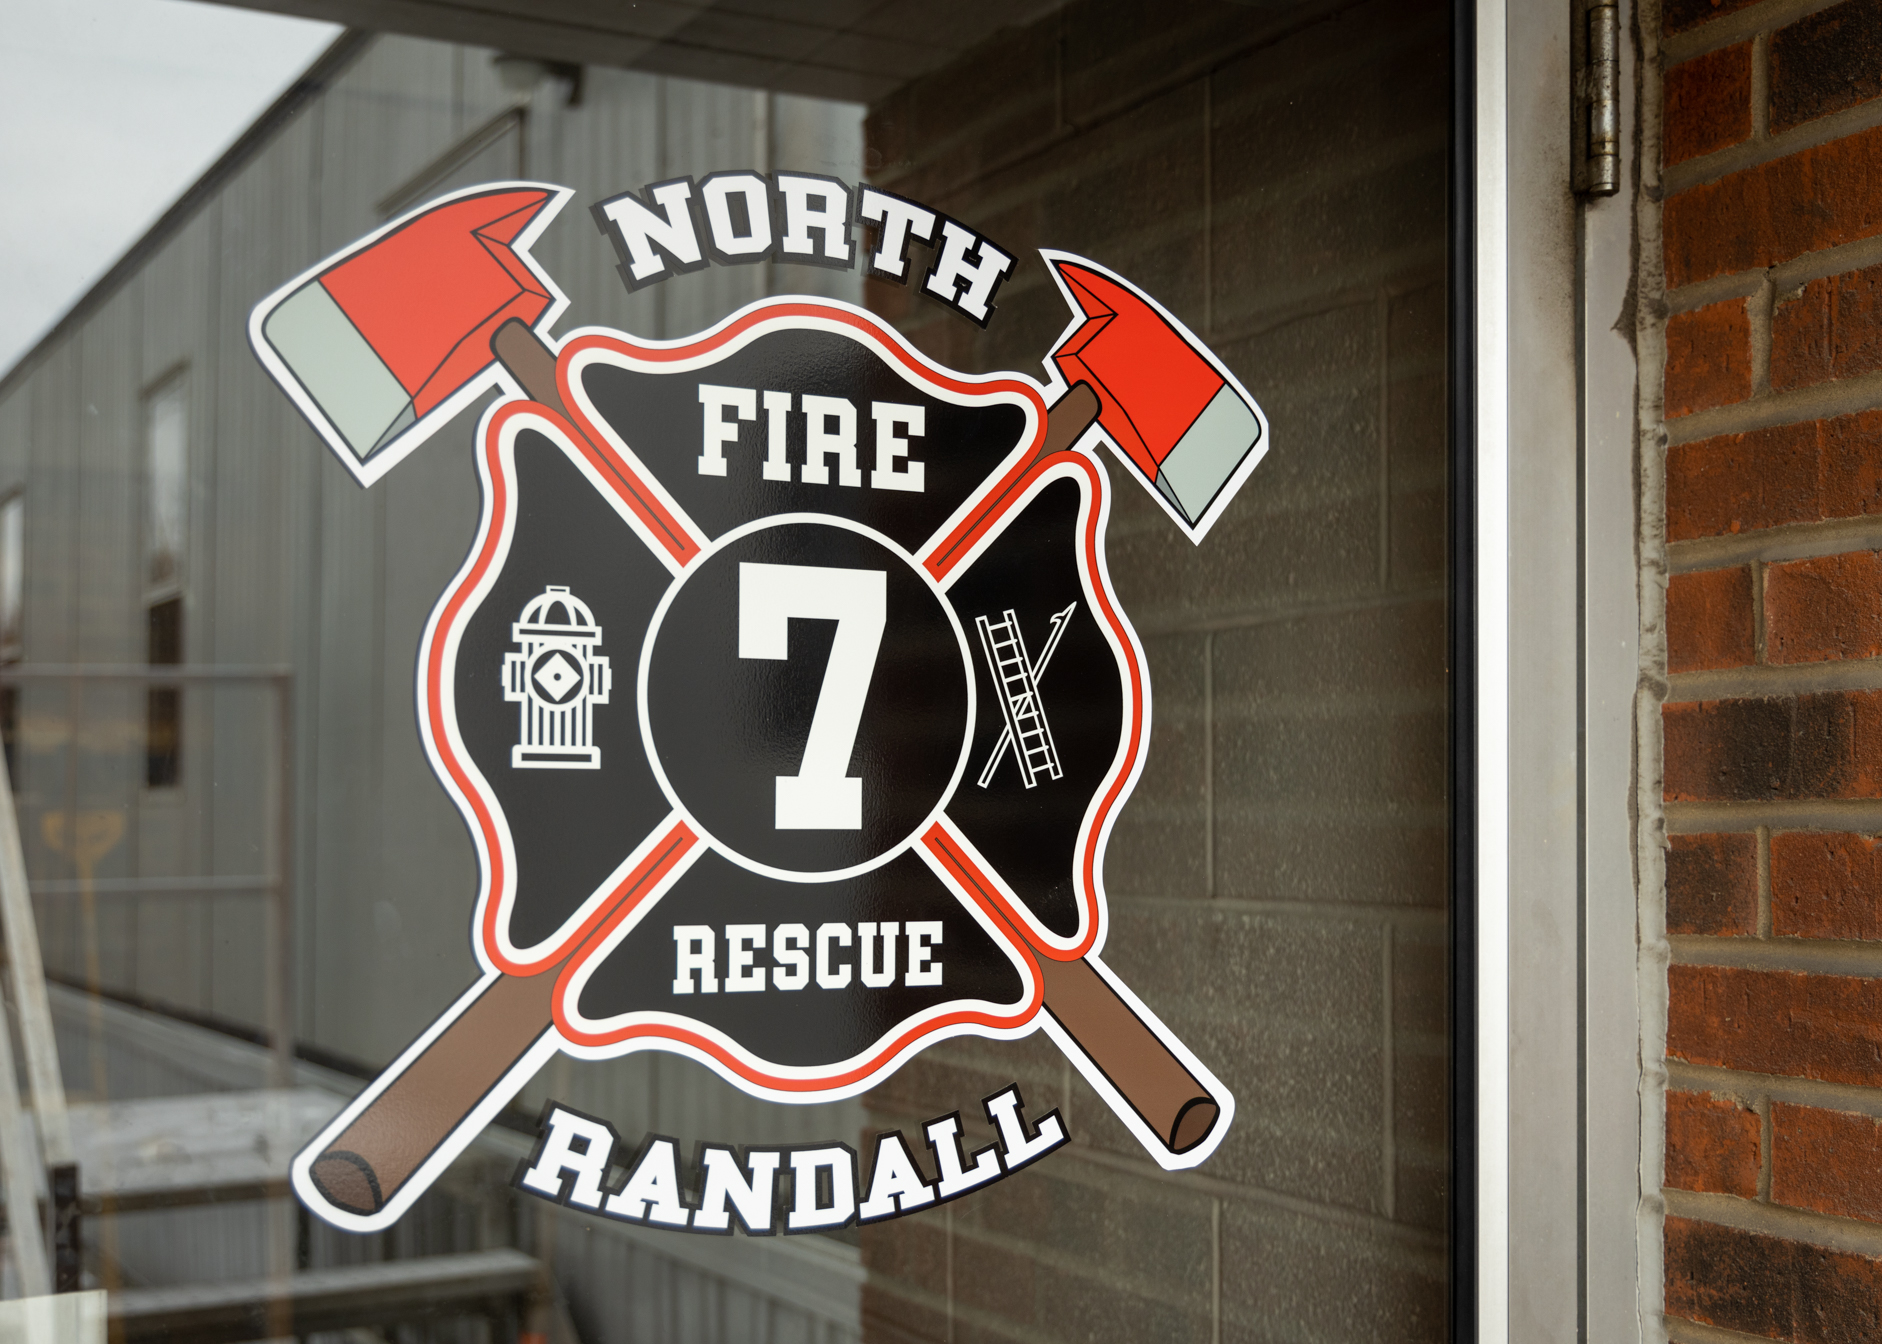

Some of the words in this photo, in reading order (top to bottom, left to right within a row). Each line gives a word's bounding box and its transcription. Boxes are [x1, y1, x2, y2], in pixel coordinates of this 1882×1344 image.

[600, 172, 1014, 324] NORTH
[698, 384, 925, 492] FIRE
[737, 563, 888, 831] 7
[673, 921, 943, 994] RESCUE
[520, 1087, 1073, 1232] RANDALL
